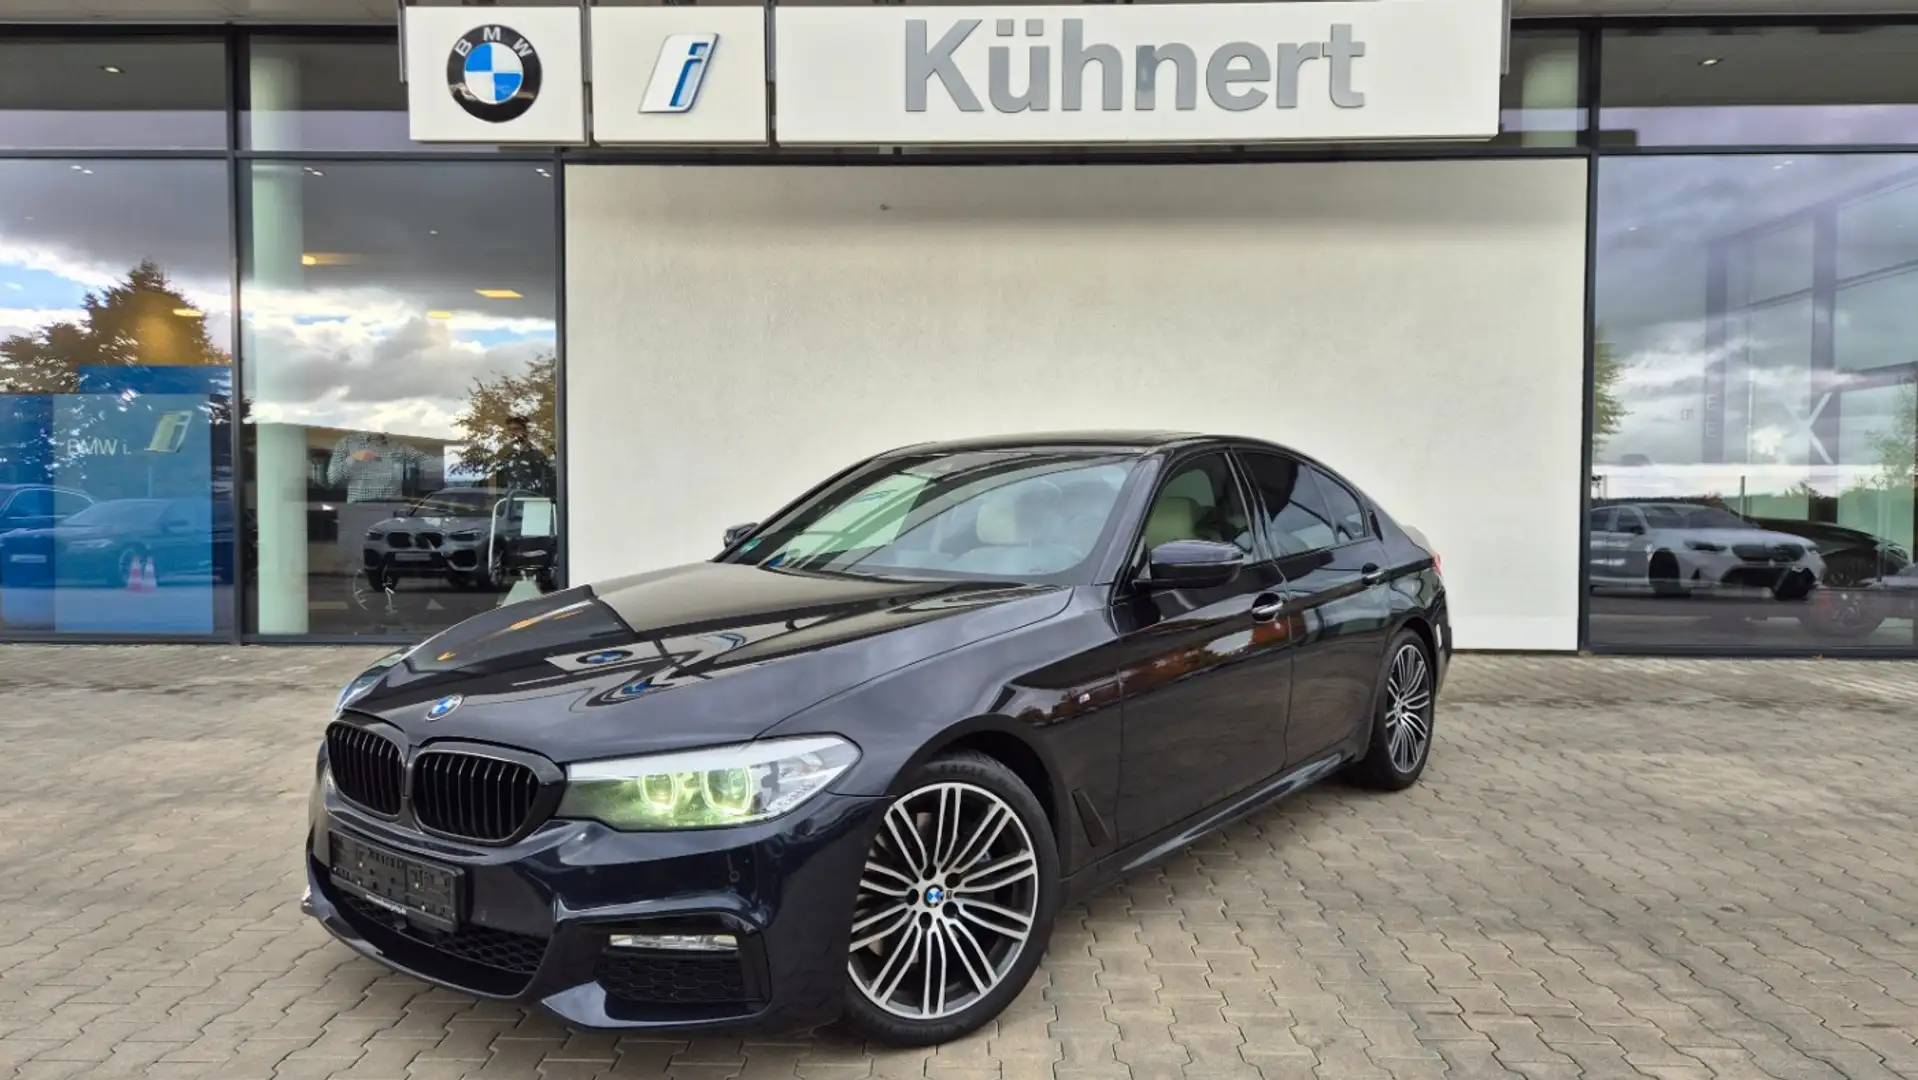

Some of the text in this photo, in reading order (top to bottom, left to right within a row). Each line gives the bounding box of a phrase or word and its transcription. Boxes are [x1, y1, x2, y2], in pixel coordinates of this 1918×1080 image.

[454, 26, 534, 57] BMW
[905, 18, 1366, 114] Kühnert
[67, 437, 118, 455] BMW
